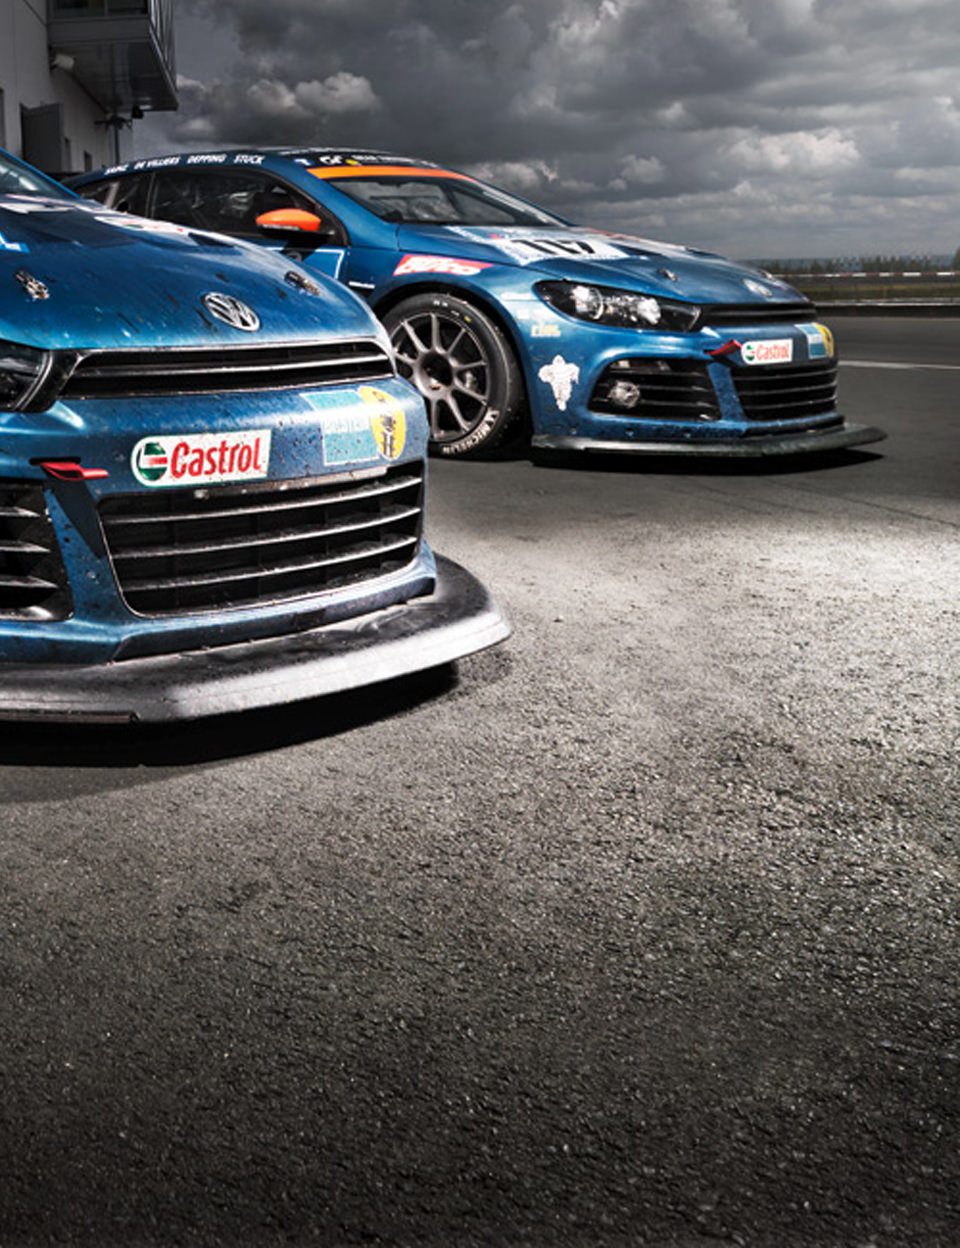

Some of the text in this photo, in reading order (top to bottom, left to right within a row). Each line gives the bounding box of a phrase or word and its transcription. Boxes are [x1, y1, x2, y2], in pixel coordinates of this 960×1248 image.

[187, 154, 228, 165] DEPPING
[233, 154, 267, 166] STUCK
[756, 344, 790, 361] Castrol
[170, 437, 262, 479] Castrol
